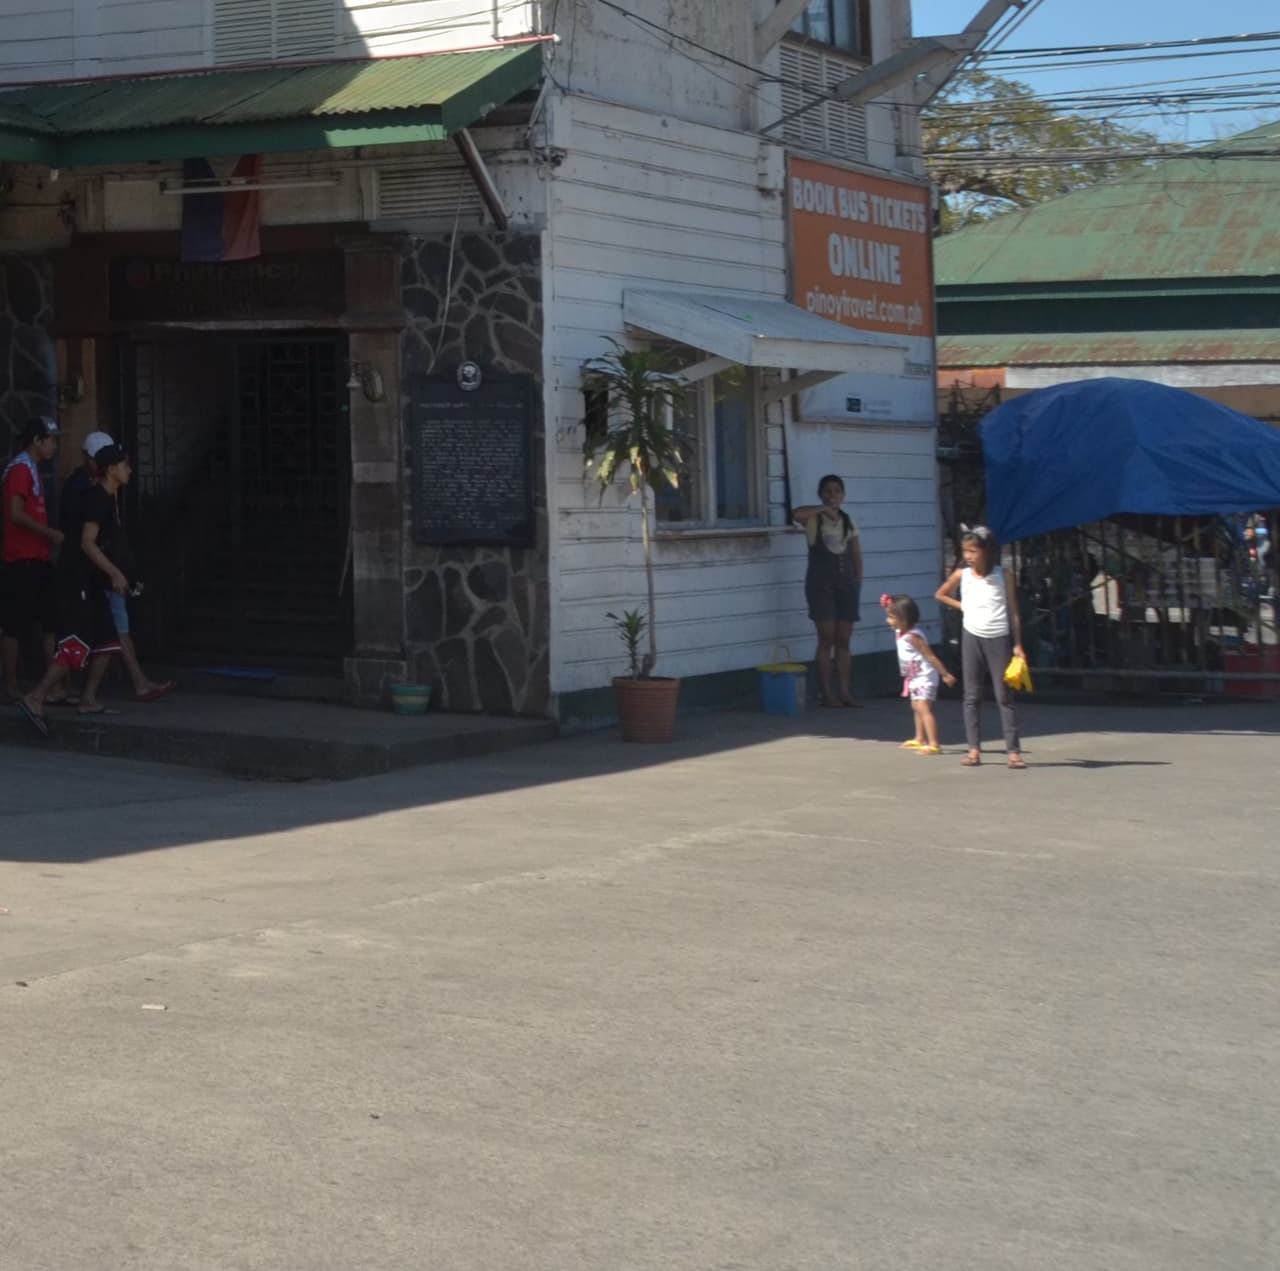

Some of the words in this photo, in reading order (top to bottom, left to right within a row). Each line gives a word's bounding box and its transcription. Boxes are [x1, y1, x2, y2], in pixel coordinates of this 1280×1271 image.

[792, 177, 836, 216] BOOK
[838, 187, 870, 223] BUS
[871, 194, 927, 233] TICKETS
[828, 232, 903, 286] ONLINE
[806, 285, 923, 329] pinoytravel.com.ph
